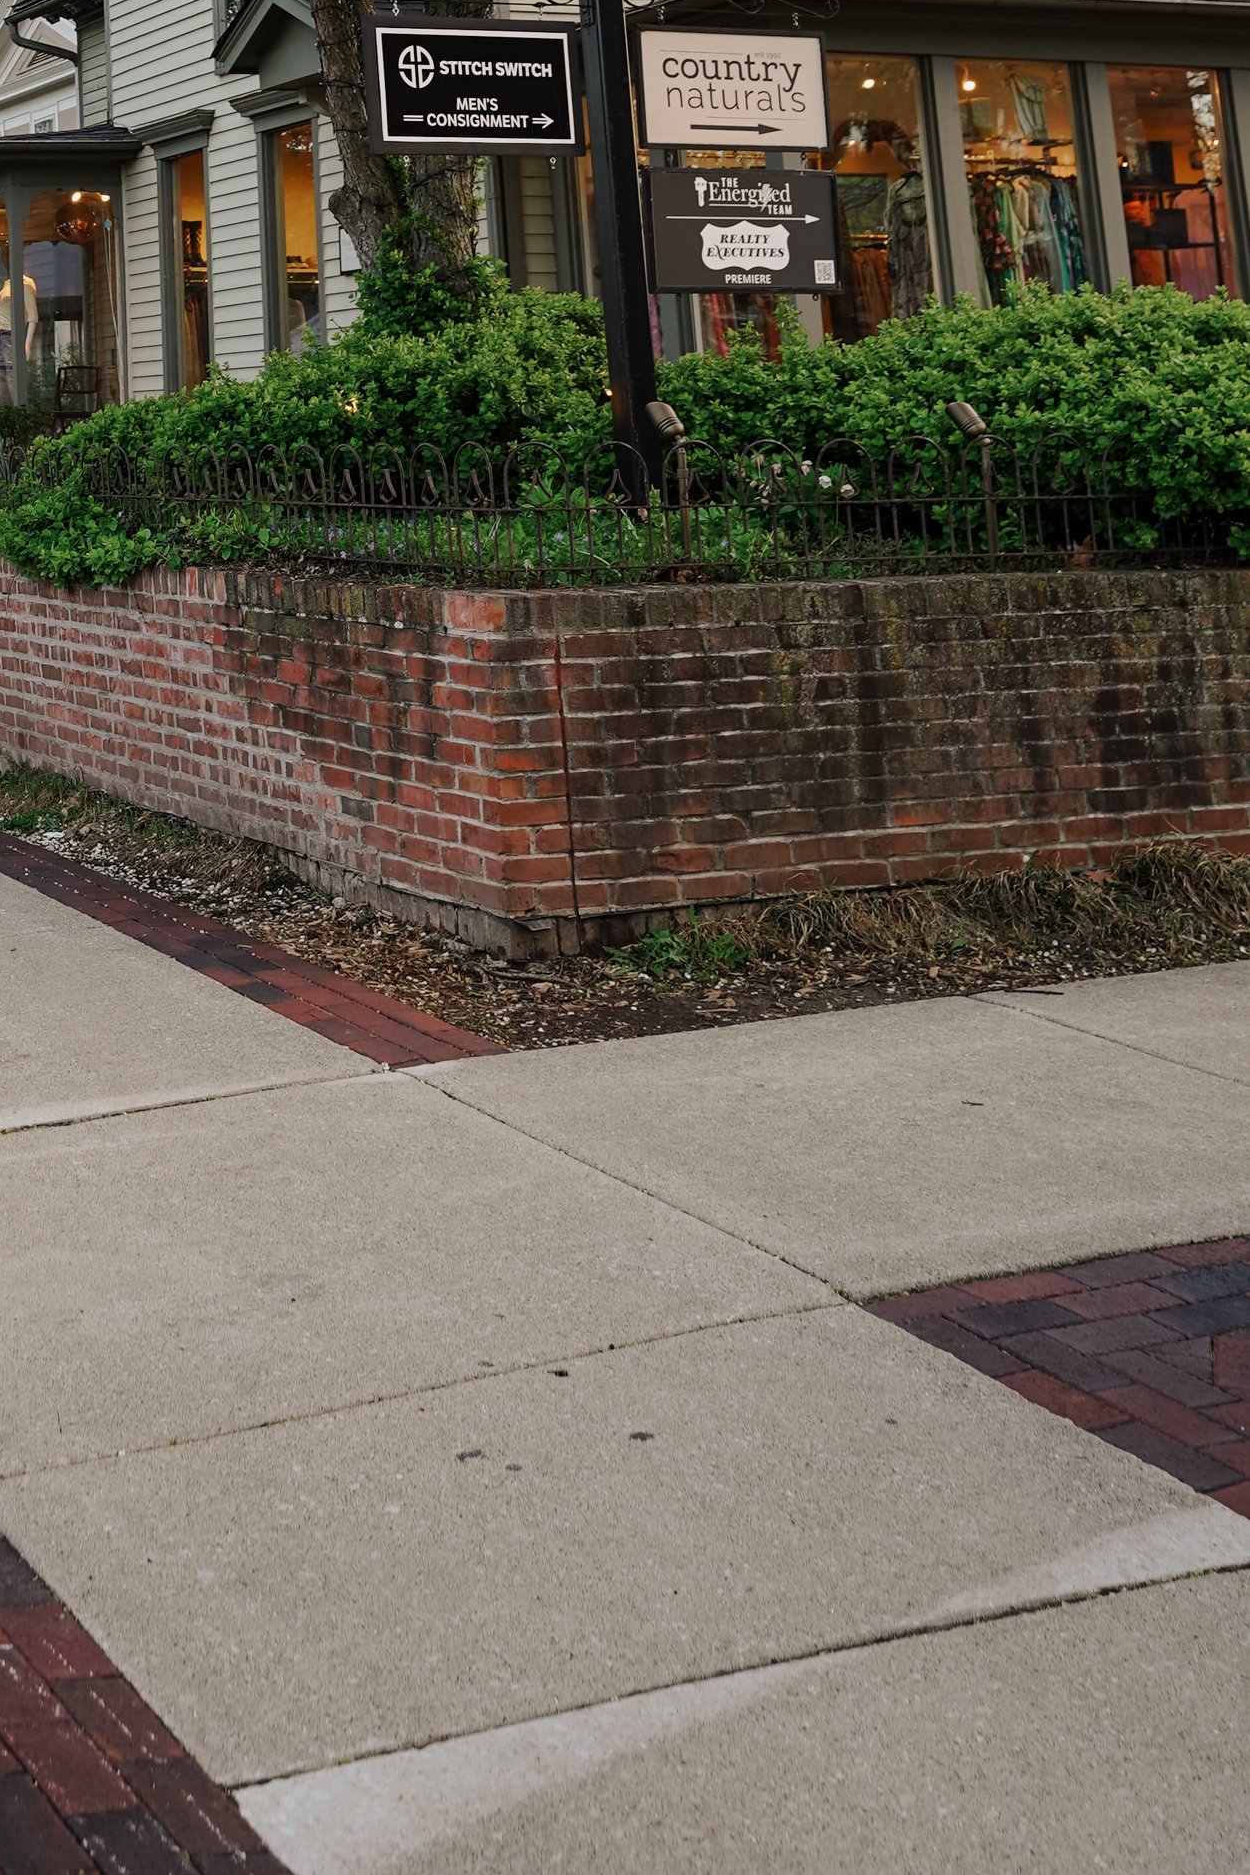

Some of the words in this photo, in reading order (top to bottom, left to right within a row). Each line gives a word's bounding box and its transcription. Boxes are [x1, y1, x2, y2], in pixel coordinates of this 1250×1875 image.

[439, 60, 493, 76] STITCH
[495, 62, 553, 78] SWITCH
[662, 54, 802, 93] country
[456, 97, 499, 112] MEN'S
[666, 82, 806, 113] naturals
[426, 112, 529, 129] CONSIGNMENT
[721, 177, 739, 188] THE
[767, 204, 793, 216] TEAM
[719, 234, 771, 245] REALTY
[706, 245, 785, 260] EXECUTIVES
[725, 273, 772, 285] PREMIERE
